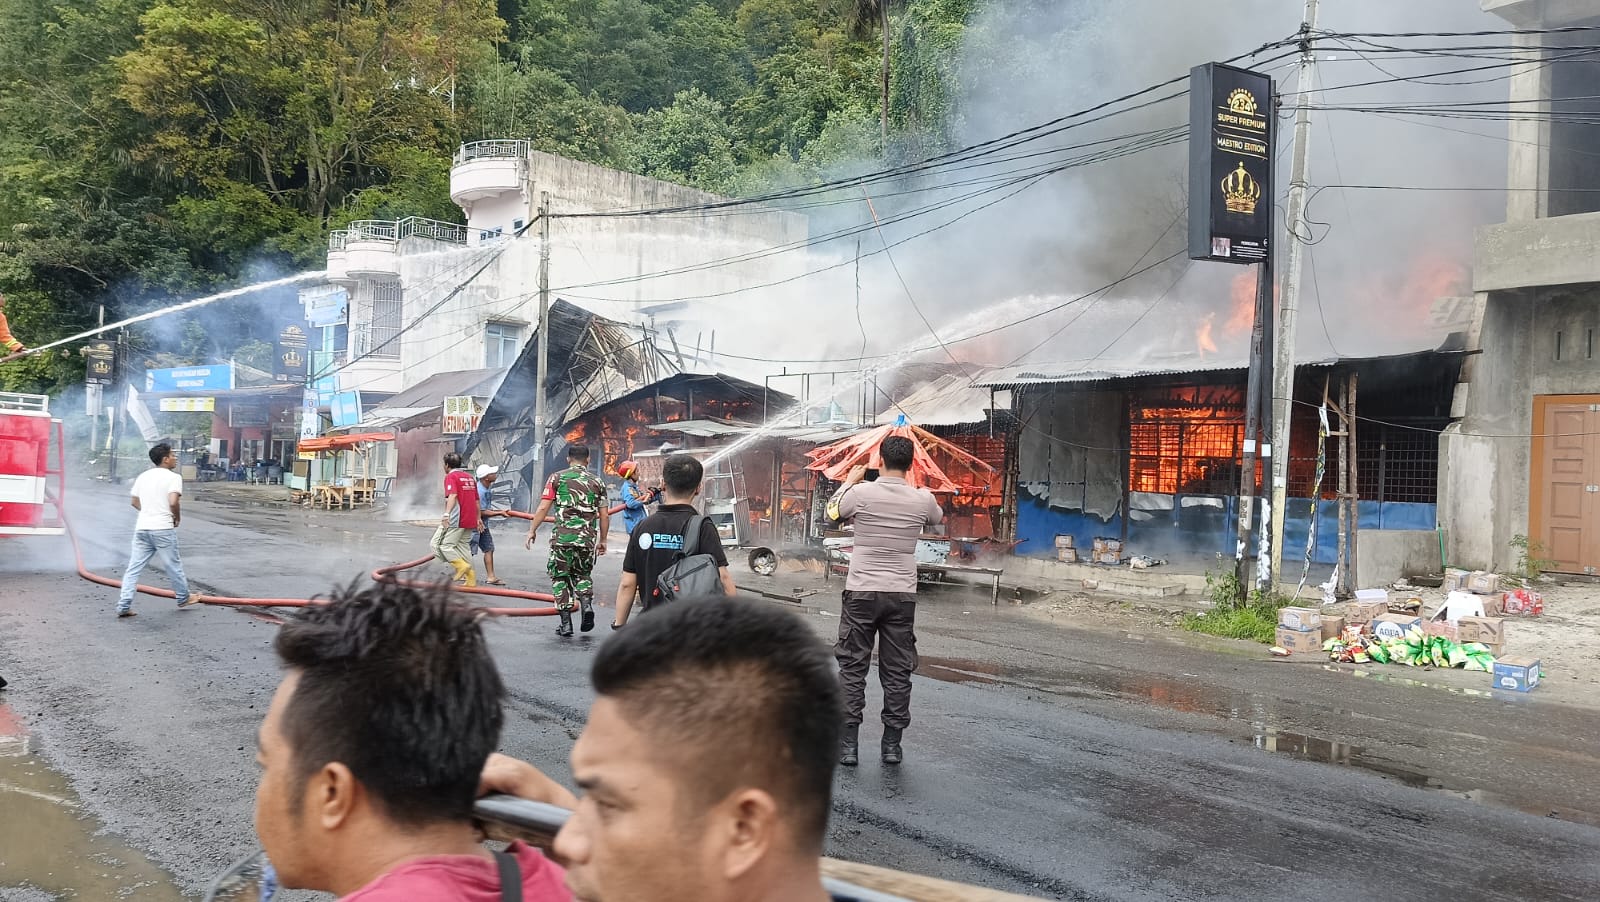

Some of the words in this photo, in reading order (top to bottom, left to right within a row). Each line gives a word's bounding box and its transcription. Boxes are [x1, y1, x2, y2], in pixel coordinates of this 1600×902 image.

[1233, 98, 1251, 112] 234
[1217, 113, 1238, 124] SUPER
[1239, 116, 1266, 130] PREMIUM
[1217, 137, 1243, 149] MAESTRO
[1244, 142, 1266, 154] EDITION
[1379, 627, 1400, 638] AQUA
